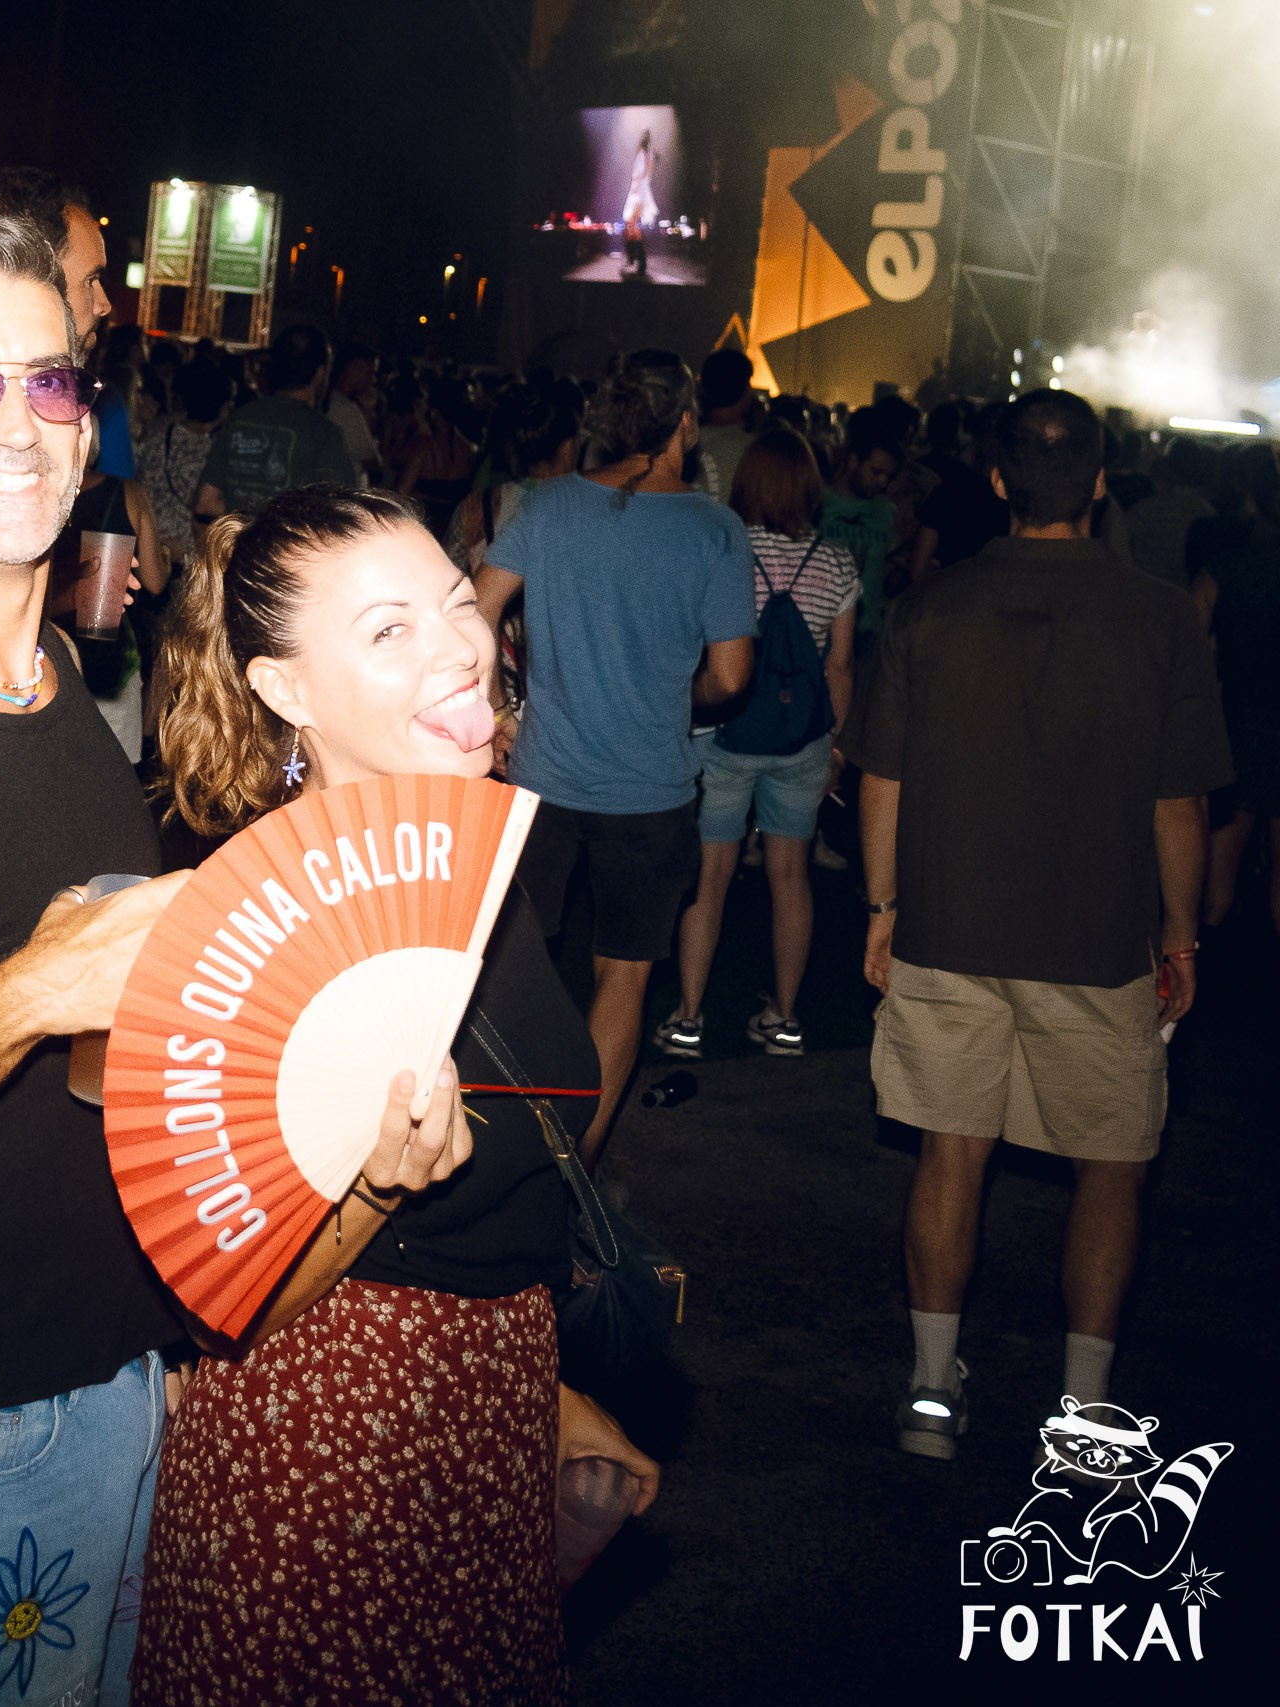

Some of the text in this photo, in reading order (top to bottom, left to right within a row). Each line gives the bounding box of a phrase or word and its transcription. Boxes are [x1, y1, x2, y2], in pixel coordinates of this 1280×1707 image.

[163, 821, 453, 1252] COLLONS QUINA CALOR
